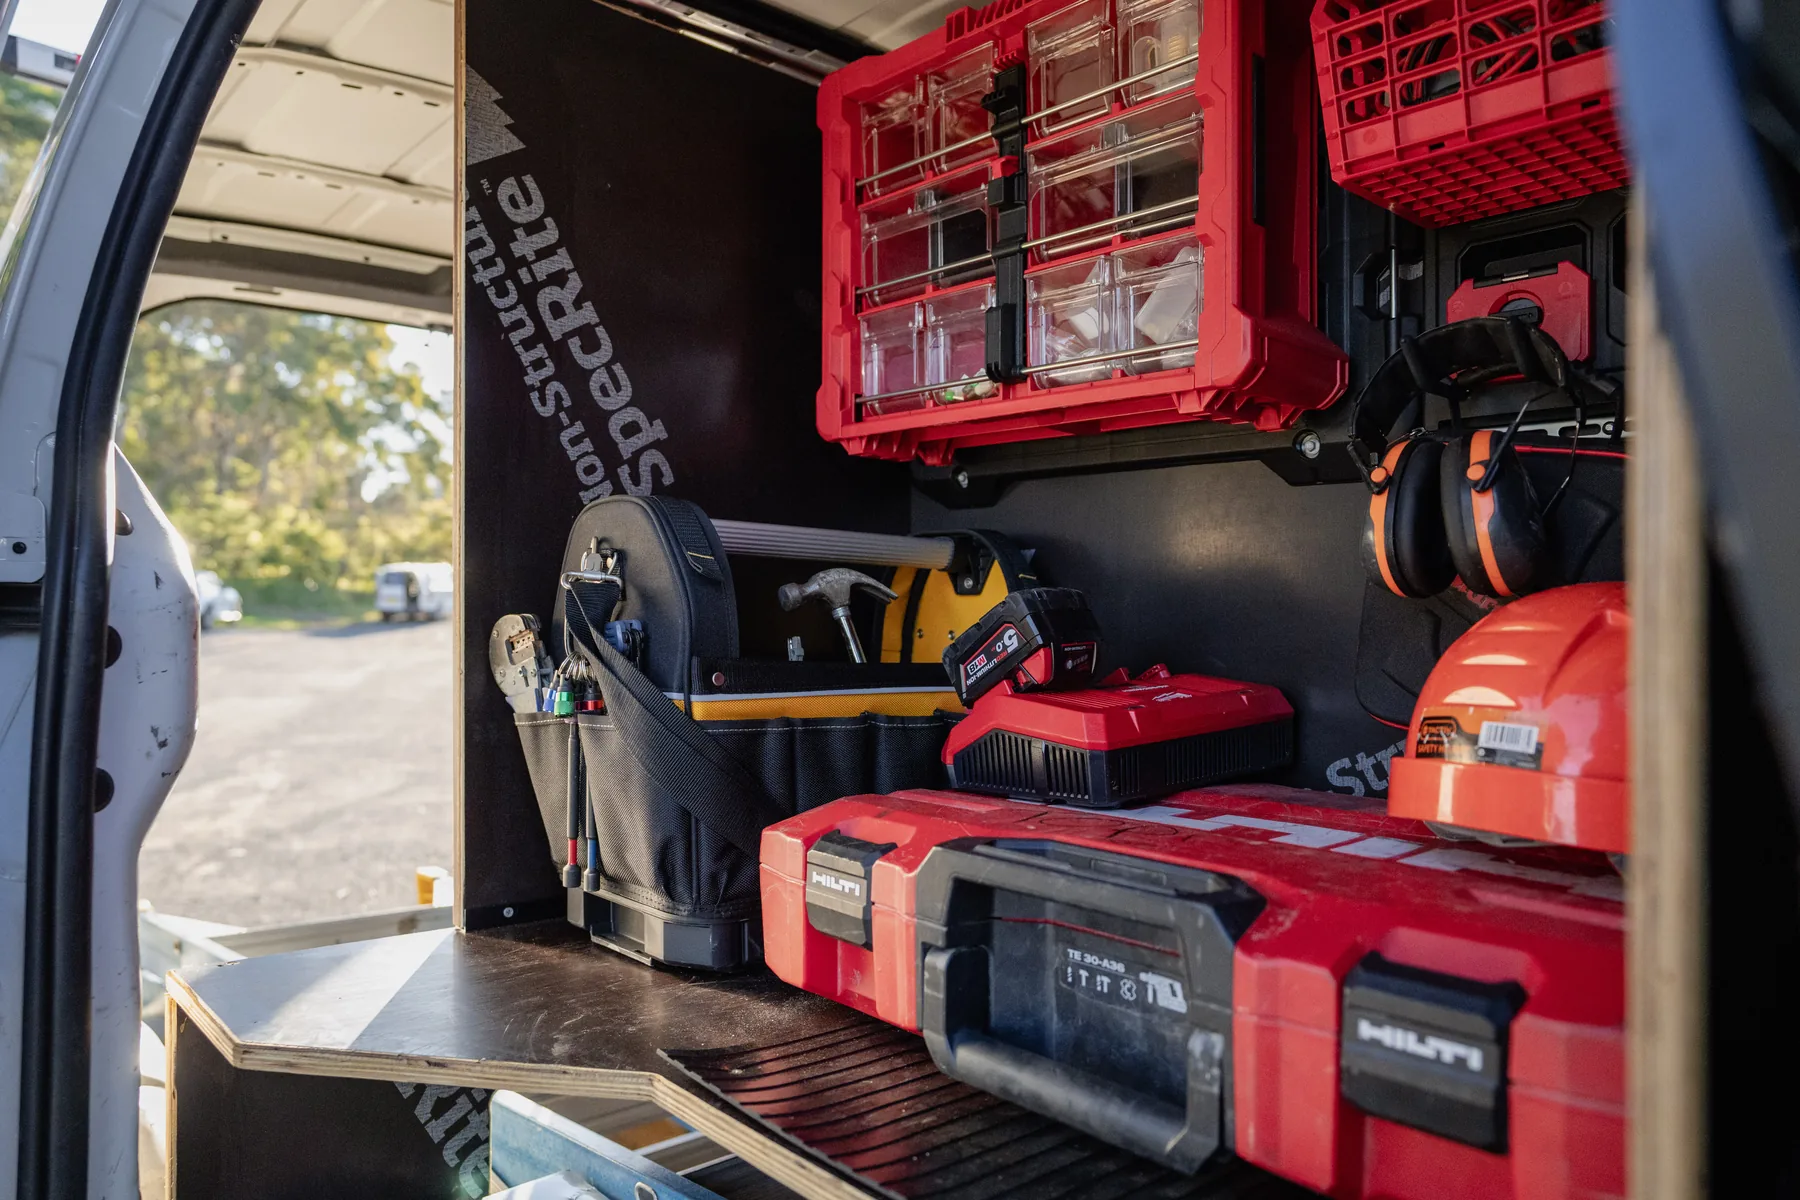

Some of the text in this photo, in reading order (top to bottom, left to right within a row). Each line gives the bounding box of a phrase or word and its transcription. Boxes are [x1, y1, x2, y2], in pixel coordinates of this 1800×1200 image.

[497, 174, 675, 496] SpecRite
[967, 655, 987, 675] M18
[812, 871, 861, 897] HILTI
[1067, 948, 1082, 960] TE
[1357, 1018, 1483, 1072] HILTI
